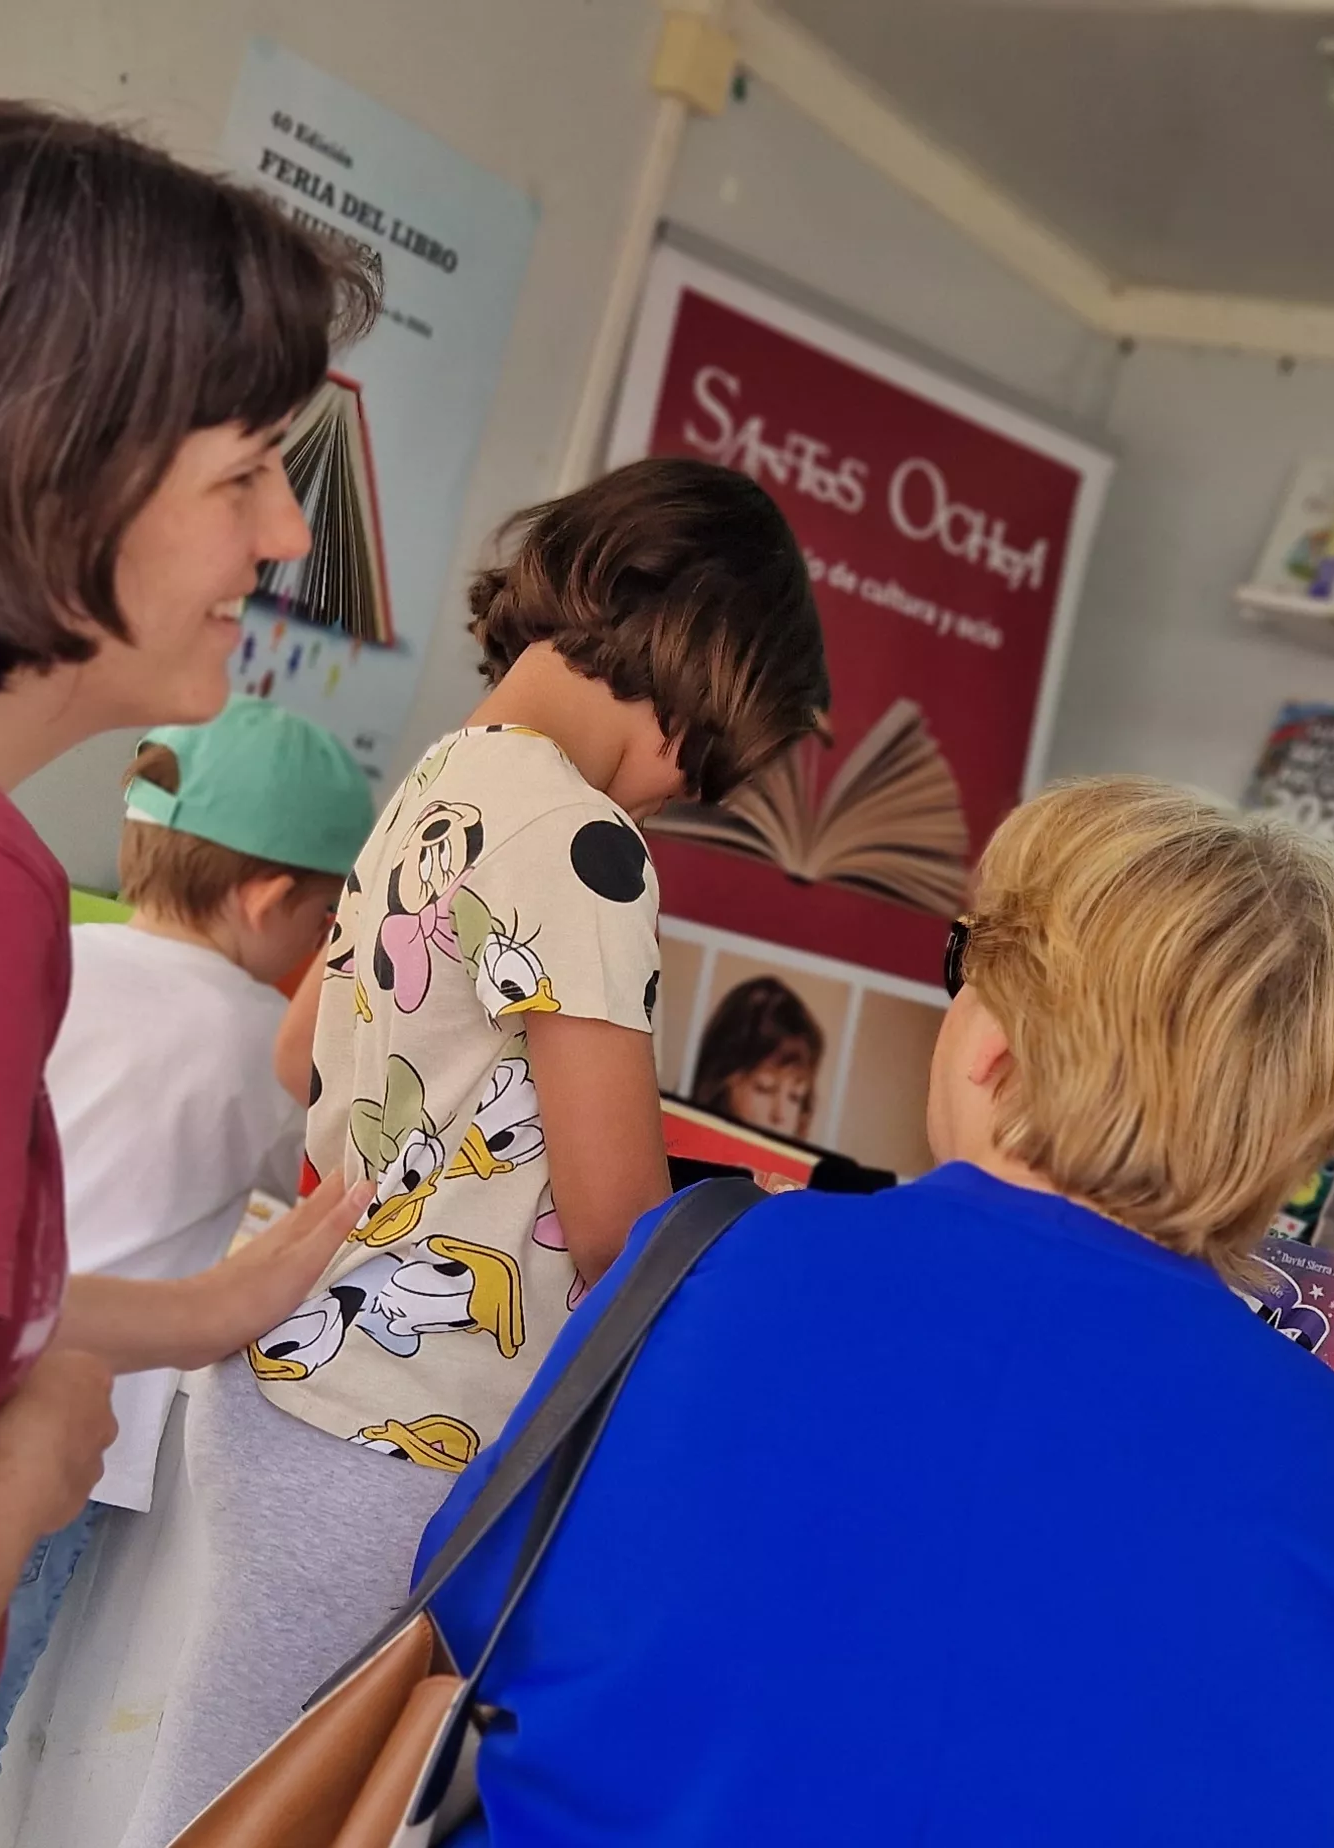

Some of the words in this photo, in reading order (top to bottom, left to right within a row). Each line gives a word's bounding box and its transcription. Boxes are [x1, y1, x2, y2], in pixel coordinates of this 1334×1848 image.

[259, 148, 334, 208] FERIA
[340, 191, 386, 236] DEL
[390, 218, 458, 274] LIBRO
[1281, 1252, 1306, 1269] David
[1306, 1260, 1332, 1276] Sierra
